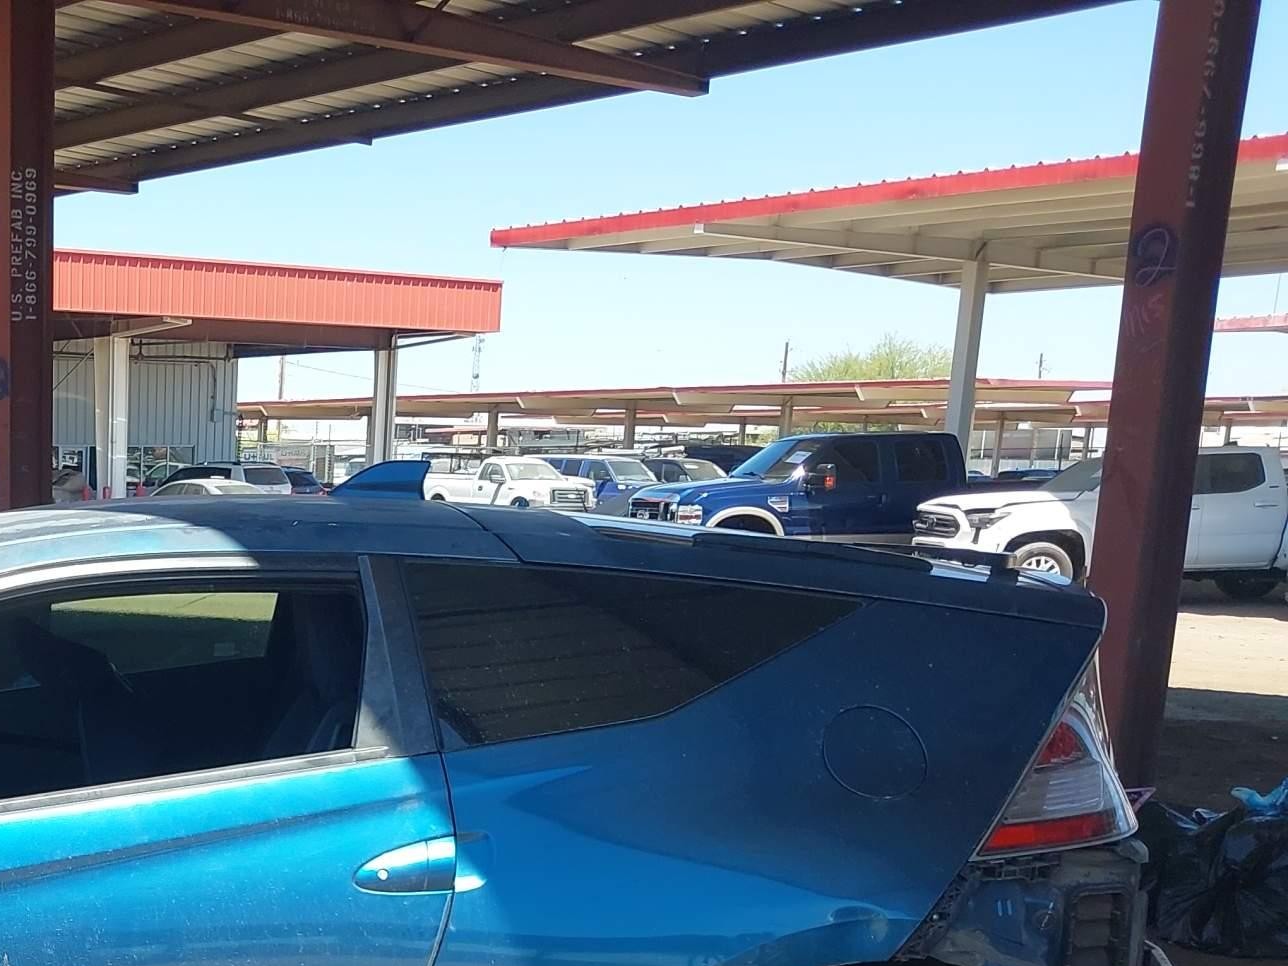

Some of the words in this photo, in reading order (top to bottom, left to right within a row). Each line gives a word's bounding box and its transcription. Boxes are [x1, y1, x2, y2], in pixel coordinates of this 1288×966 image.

[11, 209, 23, 278] PREFAB
[25, 168, 38, 320] 1-866-799-0969
[11, 288, 22, 321] U.S.
